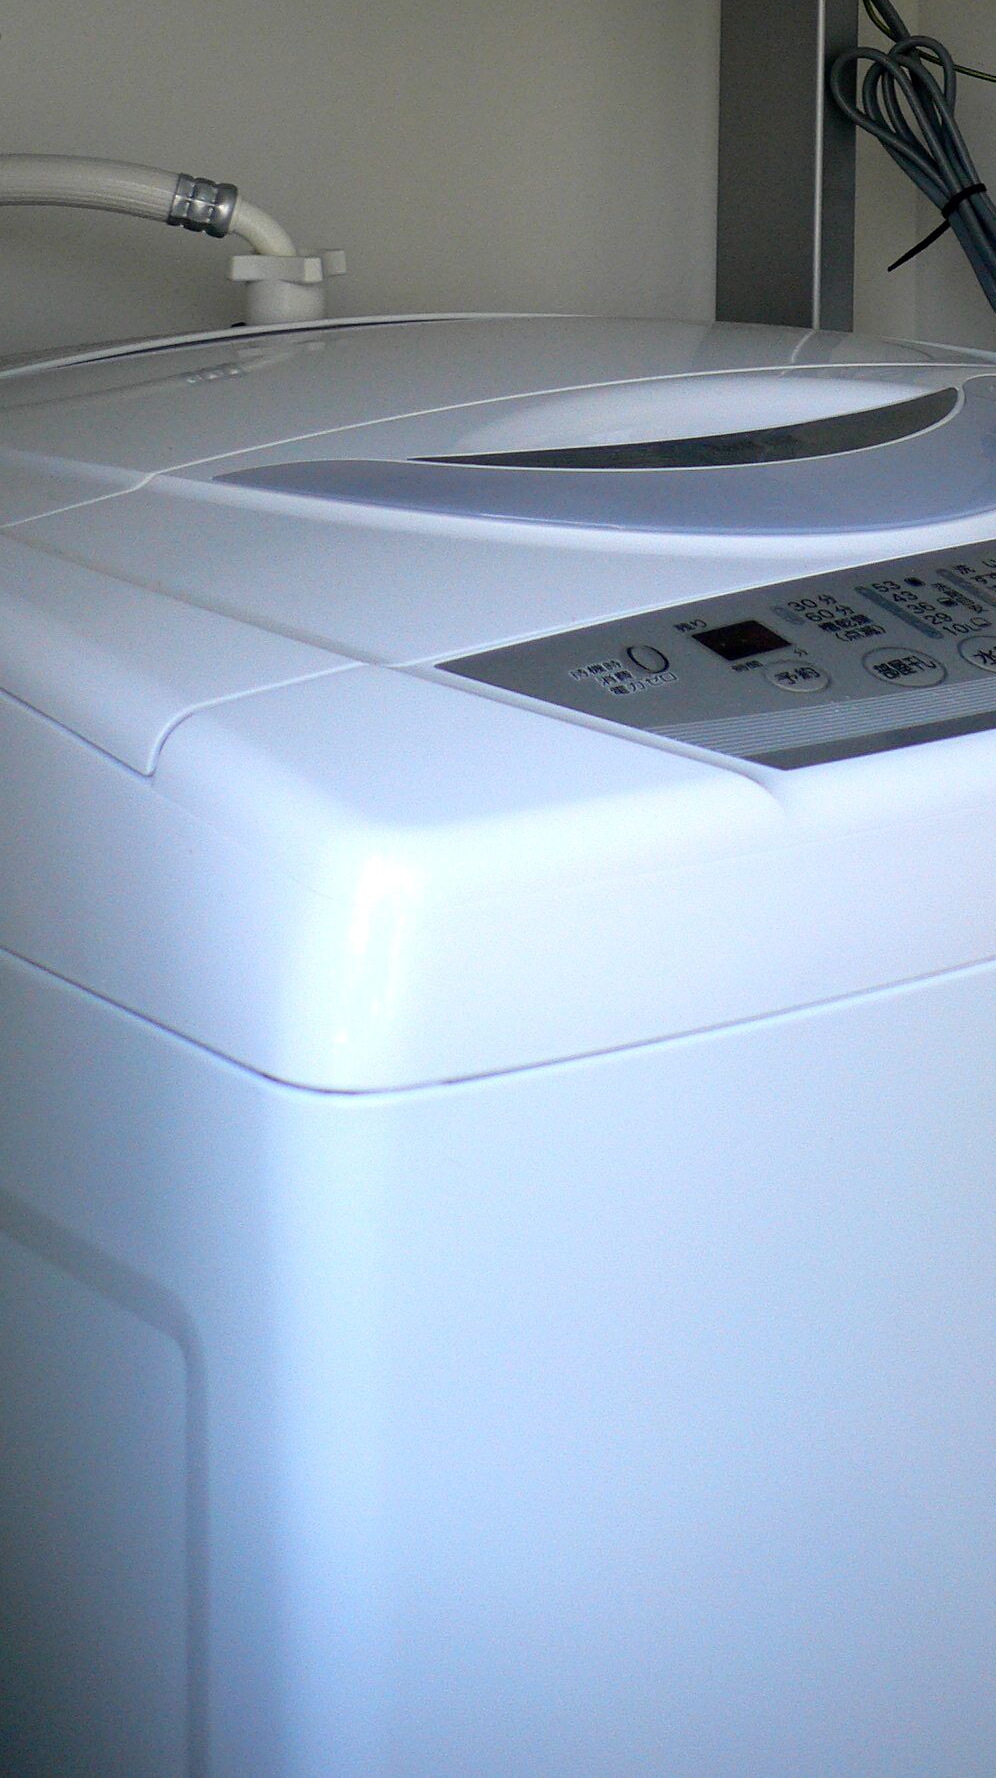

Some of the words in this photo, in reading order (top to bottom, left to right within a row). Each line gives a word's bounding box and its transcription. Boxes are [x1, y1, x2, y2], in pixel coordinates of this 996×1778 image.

[872, 580, 901, 593] 53
[892, 591, 918, 603] 43
[907, 602, 936, 615] 36
[925, 612, 953, 625] 29
[674, 618, 707, 633] 残り
[774, 666, 821, 685] 予約
[609, 672, 680, 696] 電力ゼロ
